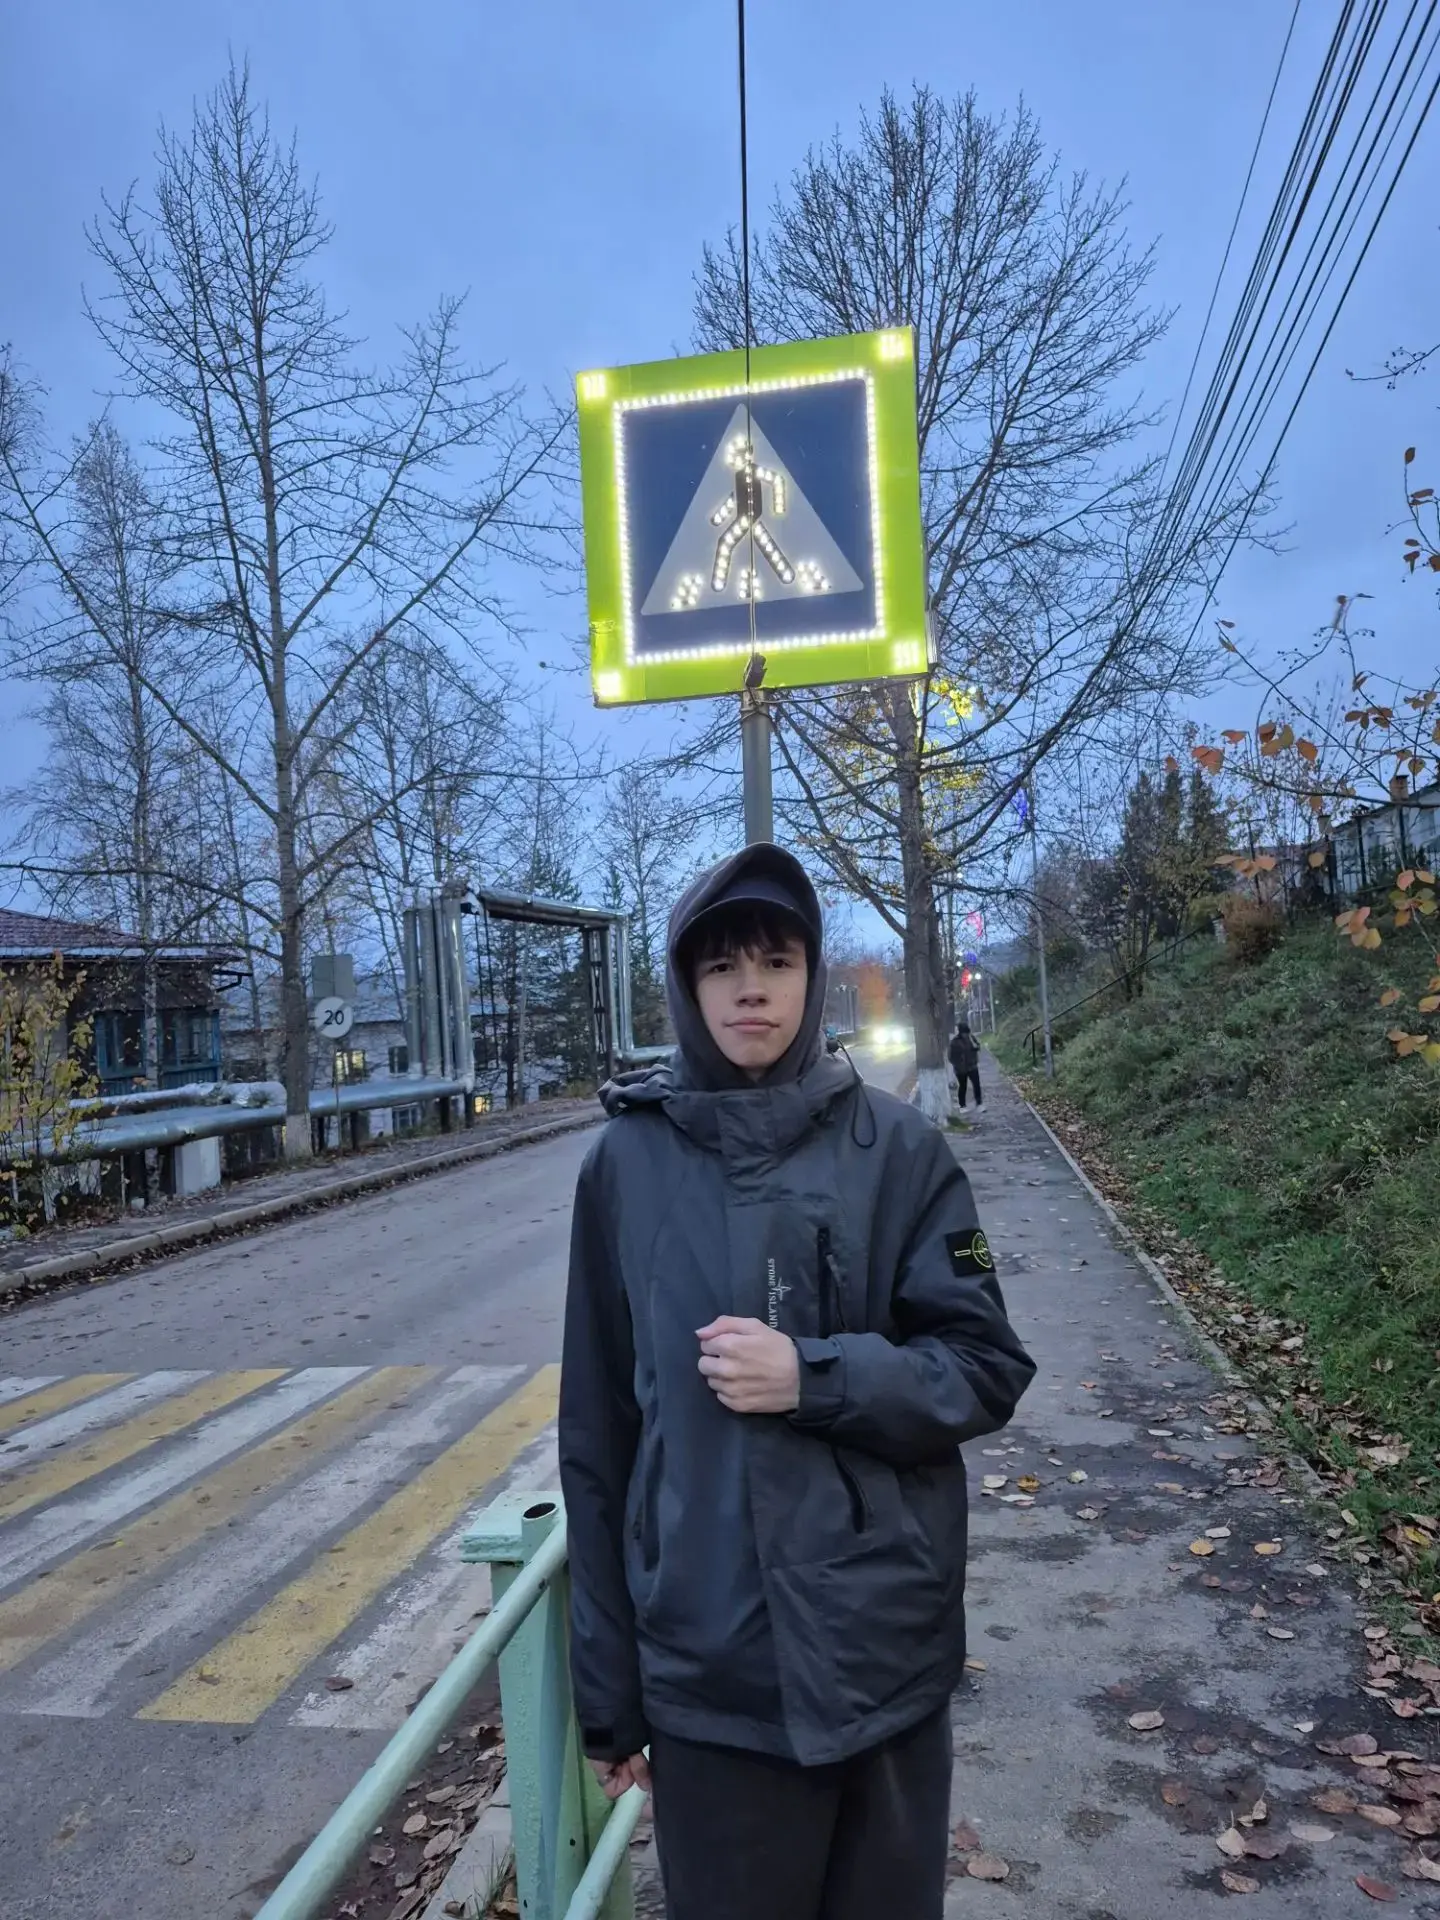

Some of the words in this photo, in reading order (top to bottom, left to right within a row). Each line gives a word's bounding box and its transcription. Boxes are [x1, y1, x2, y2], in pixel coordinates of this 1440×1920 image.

[323, 1009, 345, 1026] 20
[767, 1257, 776, 1287] STONE
[768, 1291, 778, 1328] ISLAND
